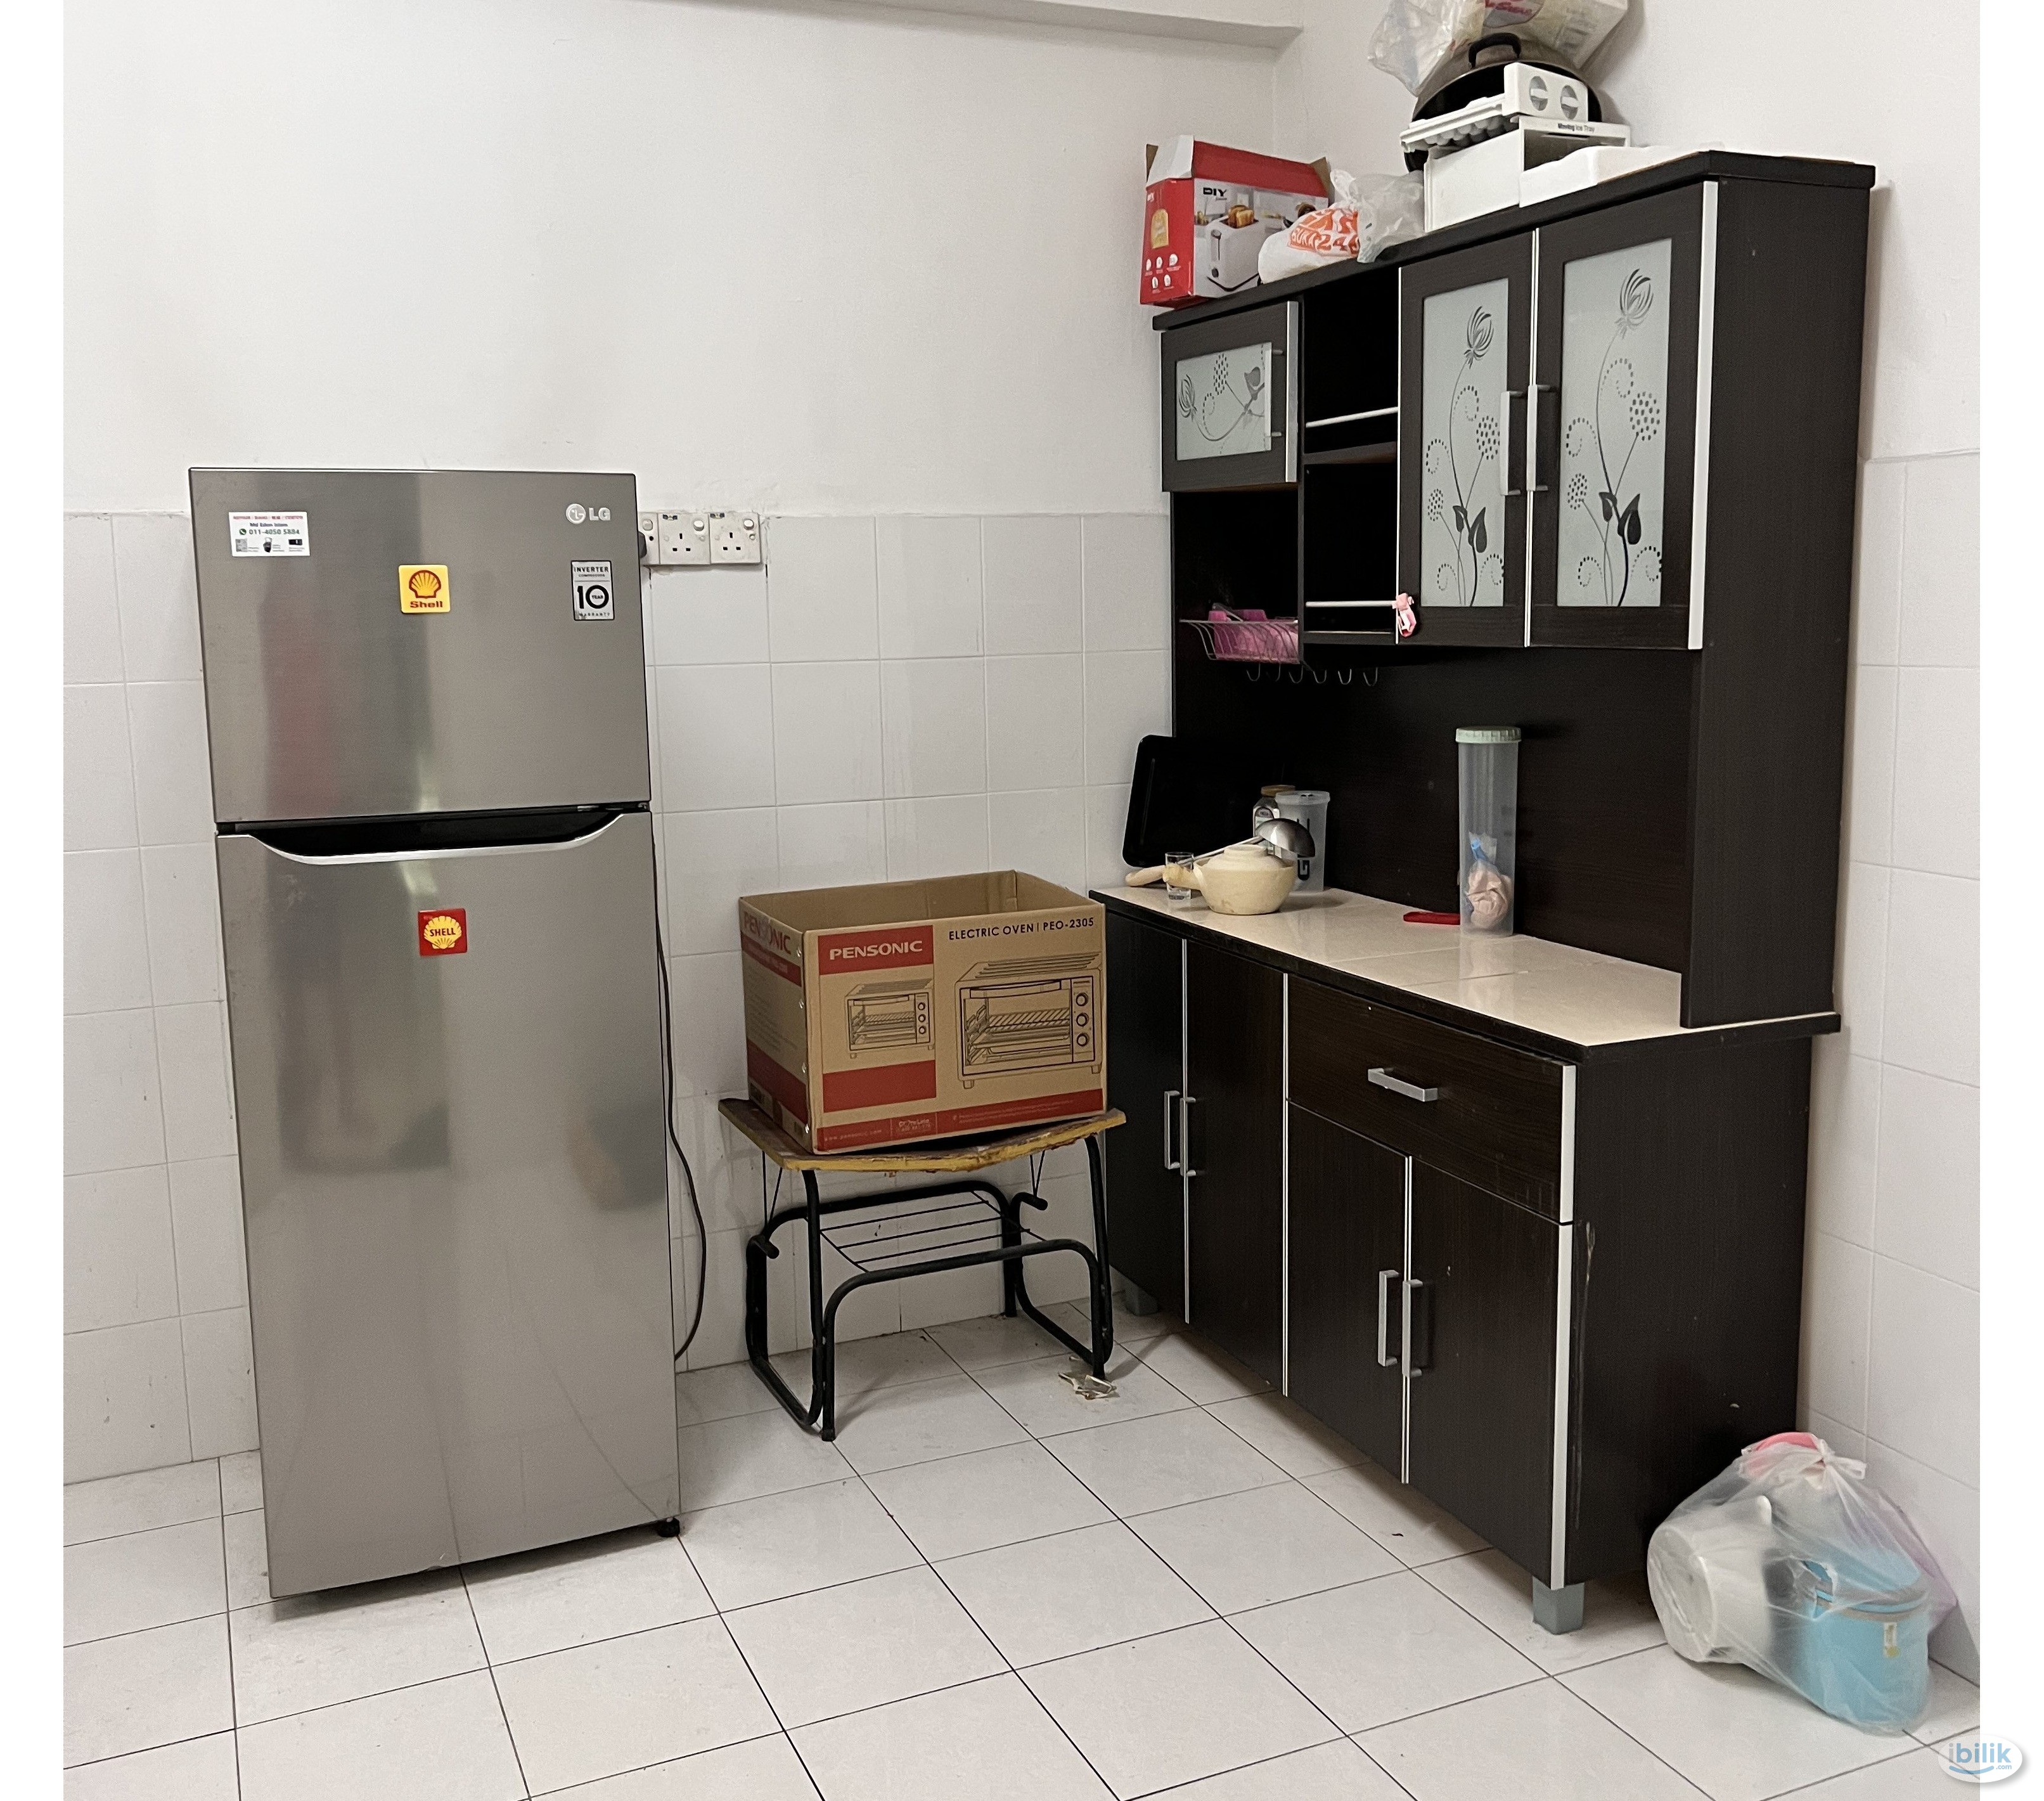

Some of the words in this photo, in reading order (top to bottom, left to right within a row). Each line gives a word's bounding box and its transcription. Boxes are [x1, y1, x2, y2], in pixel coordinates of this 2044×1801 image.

[1203, 187, 1227, 197] DIY
[589, 507, 611, 520] LG
[577, 584, 609, 609] 10
[430, 927, 456, 937] SHELL
[949, 926, 1000, 940] ELECTRIC
[1003, 922, 1034, 935] OVEN
[1043, 917, 1094, 931] PEO-2305
[830, 940, 923, 960] PENSONIC
